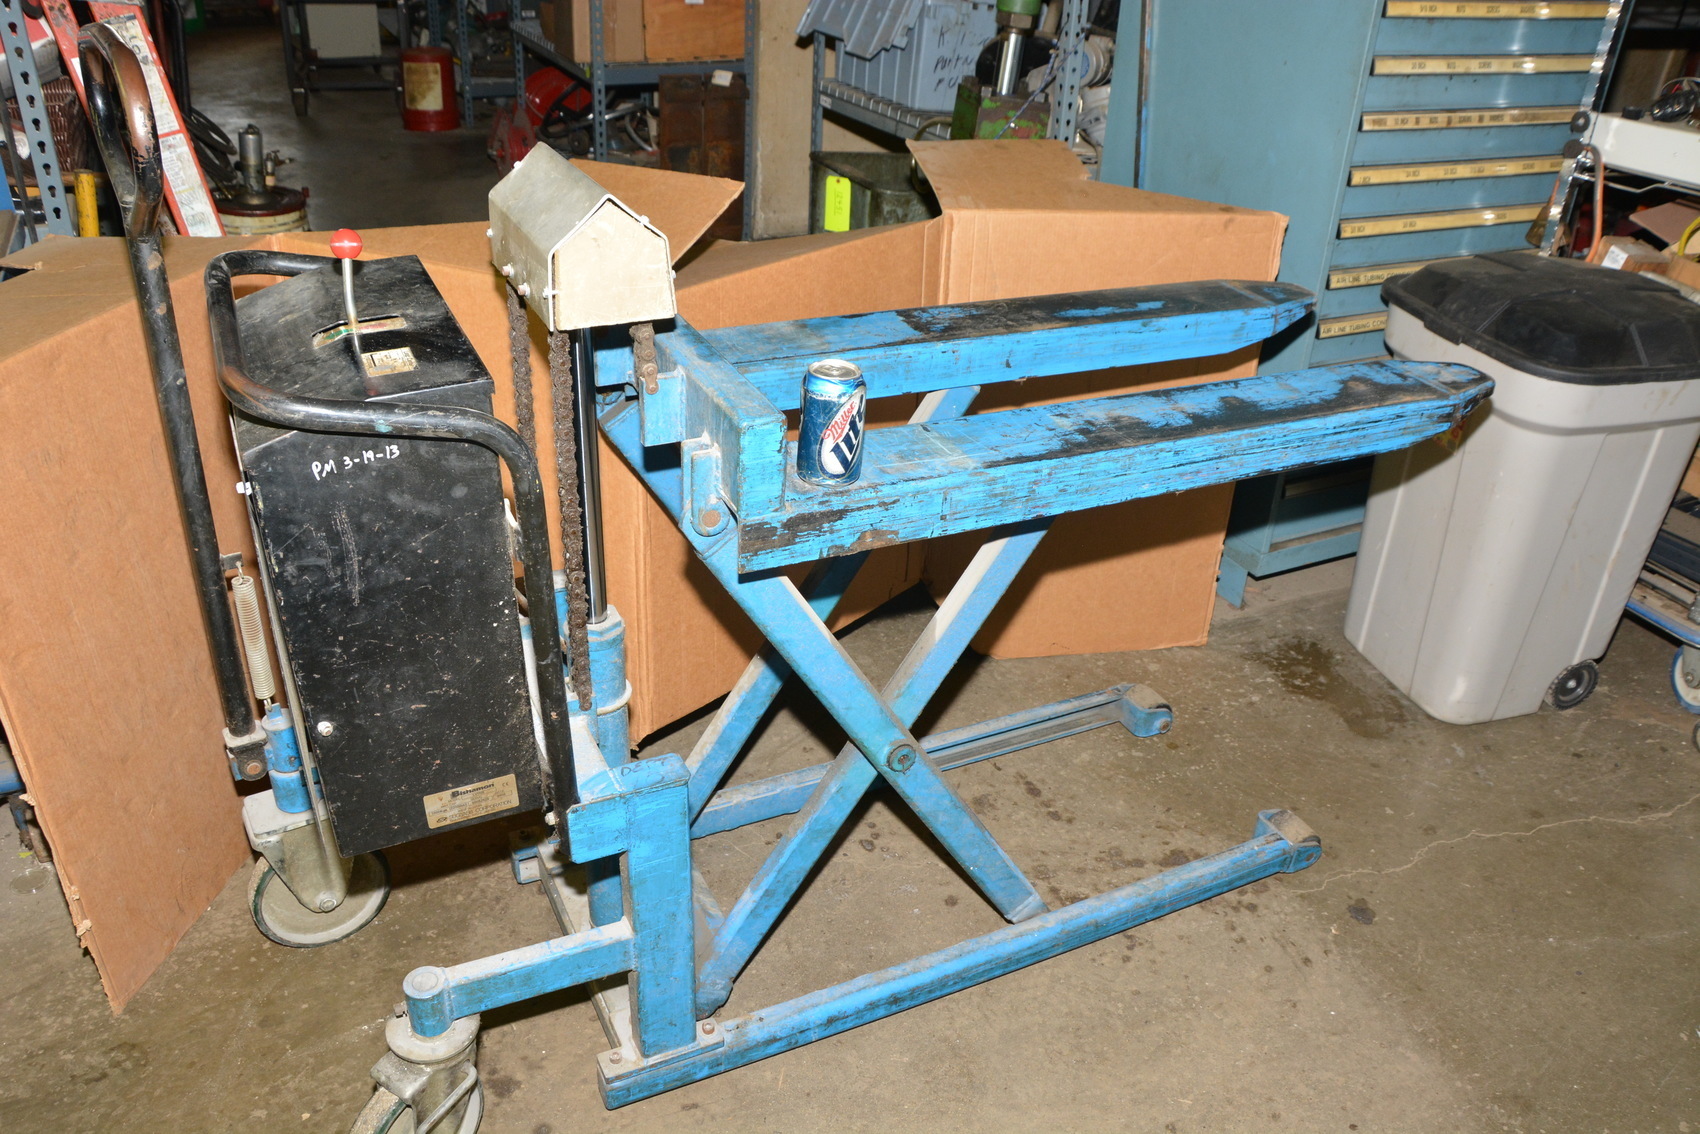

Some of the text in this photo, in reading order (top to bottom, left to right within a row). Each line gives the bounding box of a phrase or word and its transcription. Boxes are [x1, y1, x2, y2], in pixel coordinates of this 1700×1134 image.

[1348, 274, 1361, 283] LINE
[1364, 273, 1385, 282] TUBING
[1322, 327, 1333, 335] AIR
[1333, 325, 1346, 333] LINE
[1349, 323, 1371, 332] TUBING
[822, 401, 857, 444] Miller
[311, 444, 400, 481] PM 3-19-13
[451, 782, 495, 798] Bishamon
